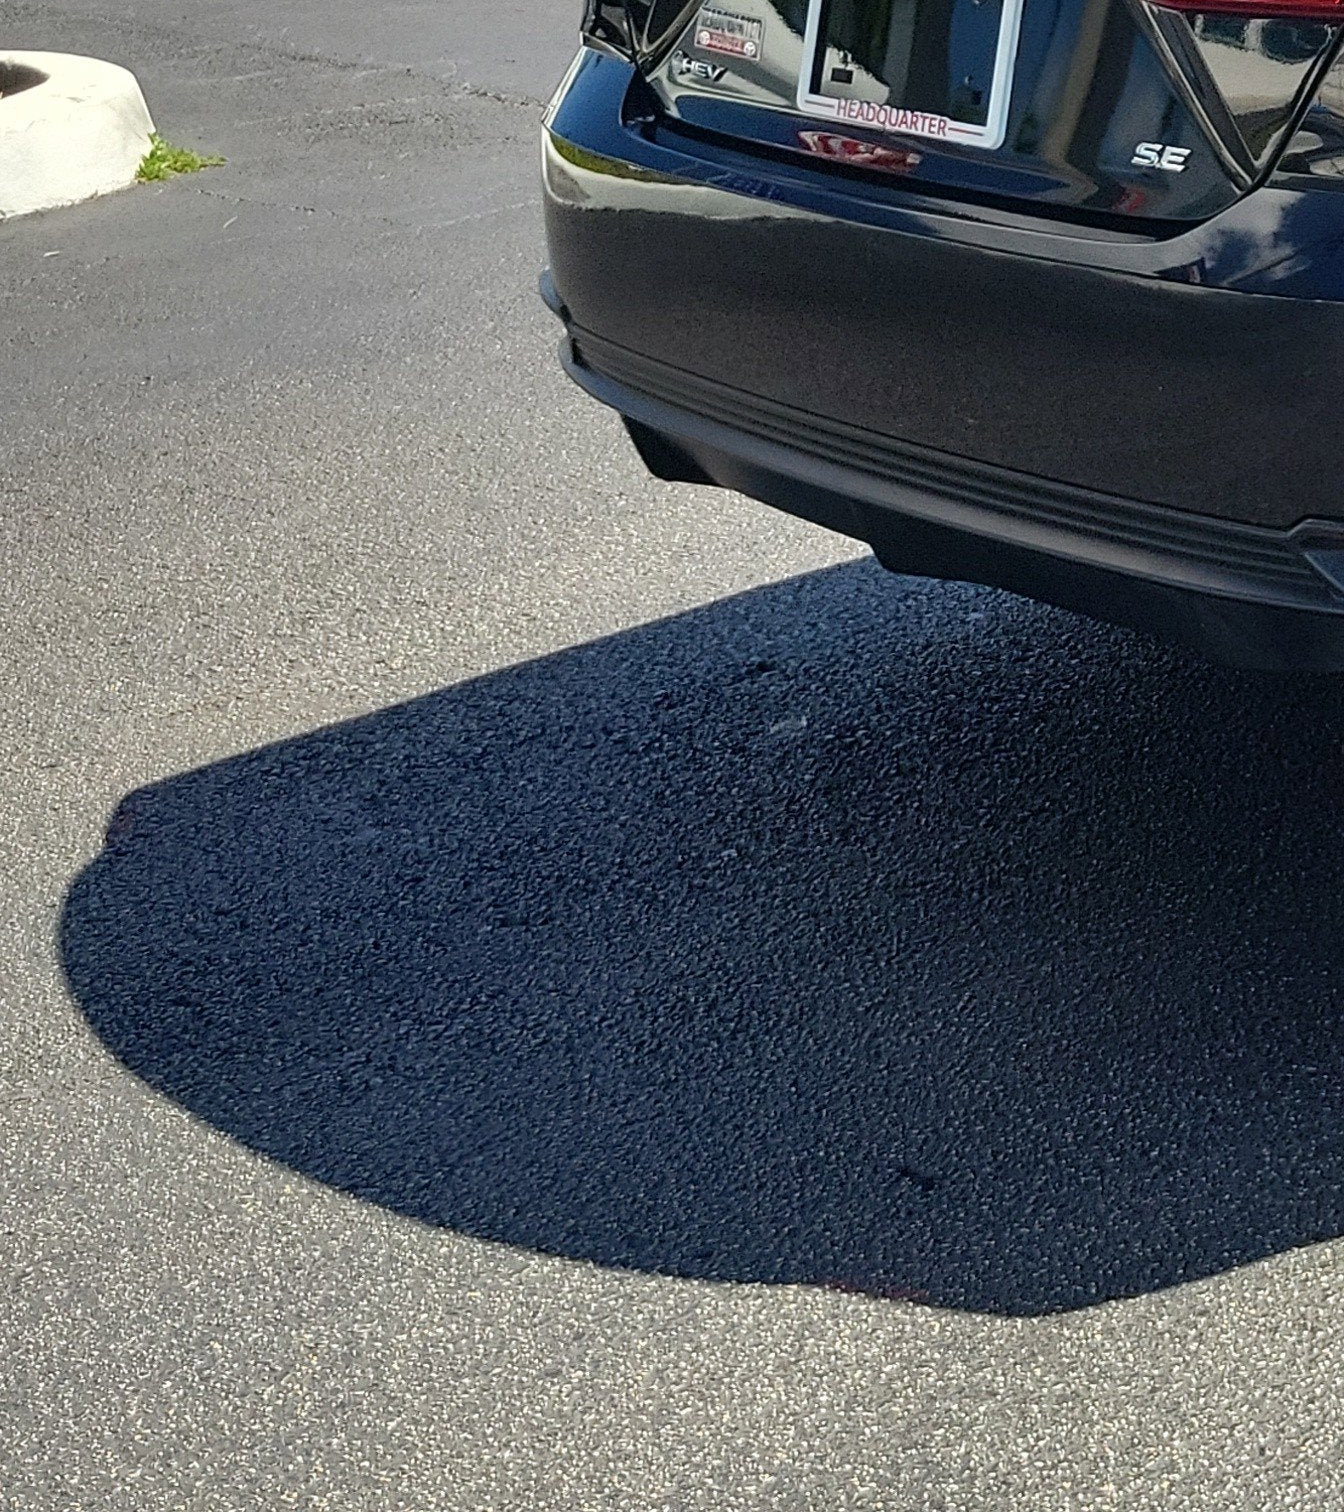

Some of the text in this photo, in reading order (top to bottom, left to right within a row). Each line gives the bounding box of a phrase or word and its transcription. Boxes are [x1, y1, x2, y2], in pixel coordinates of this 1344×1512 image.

[682, 57, 728, 81] HEV
[836, 98, 948, 137] HEADQUARTER
[1131, 141, 1192, 173] SE
